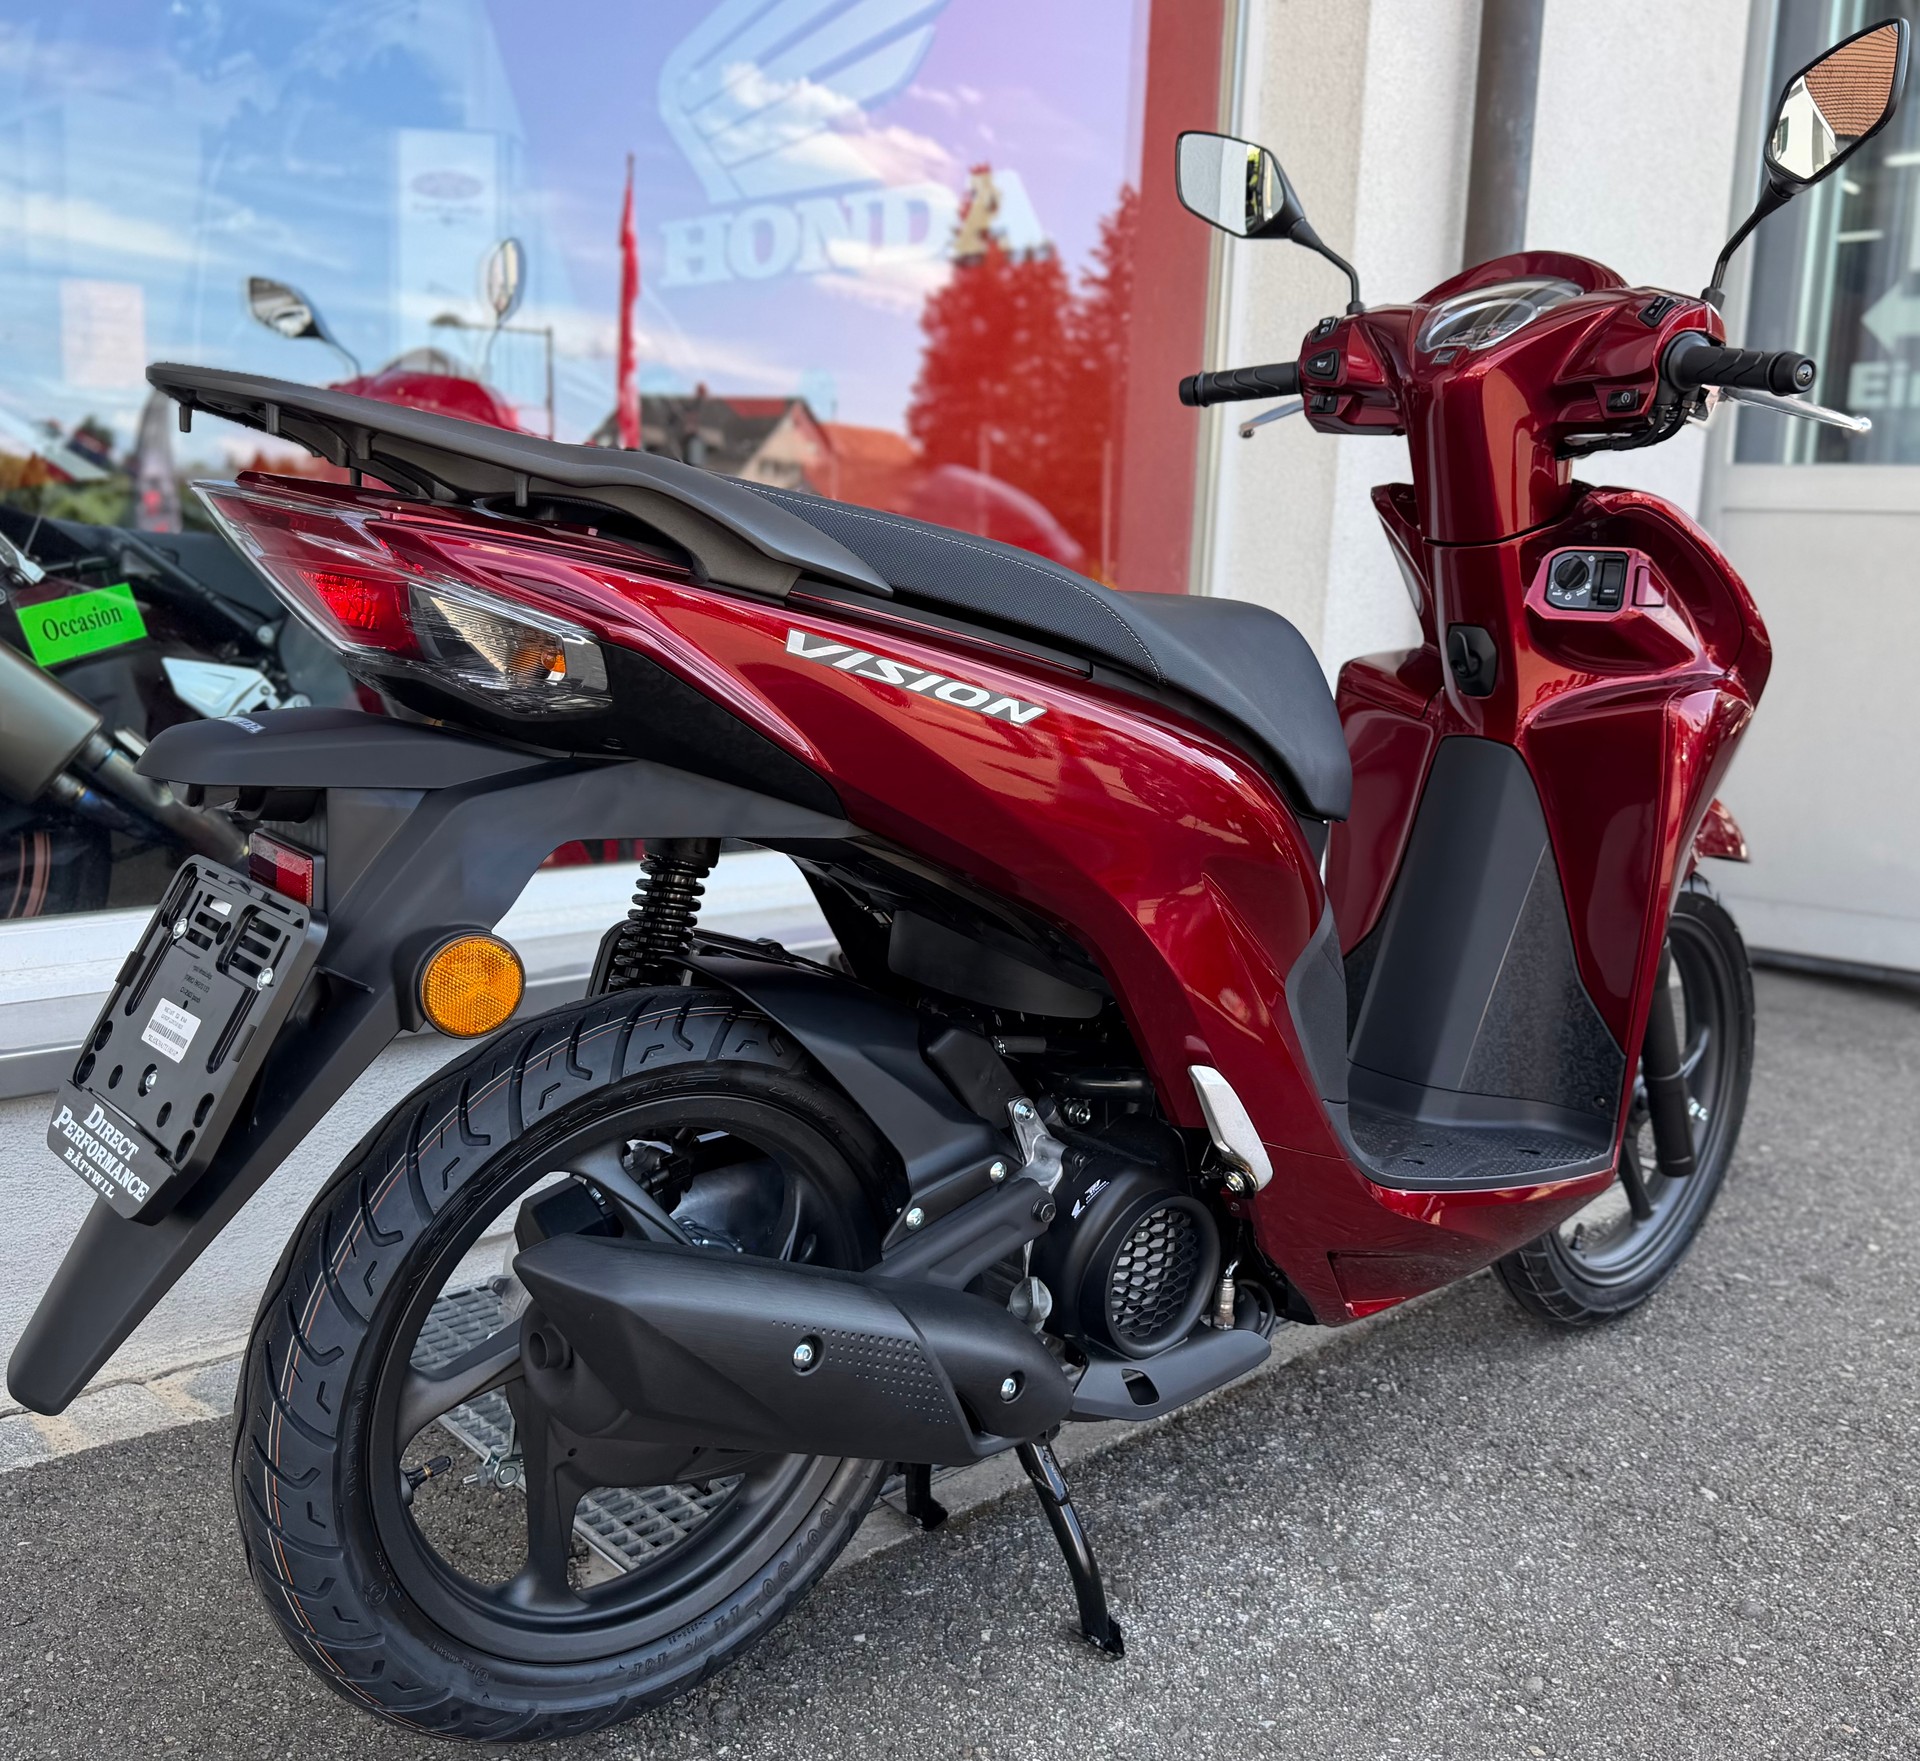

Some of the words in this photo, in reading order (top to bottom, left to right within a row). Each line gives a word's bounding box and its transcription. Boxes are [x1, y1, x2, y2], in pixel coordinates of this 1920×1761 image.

[660, 169, 1043, 287] HONDA
[42, 606, 123, 642] Occasion
[786, 629, 1047, 725] VISION
[52, 1104, 150, 1202] PERFORMANCE
[83, 1103, 139, 1161] DIRECT
[63, 1146, 115, 1199] BÄTTWIL
